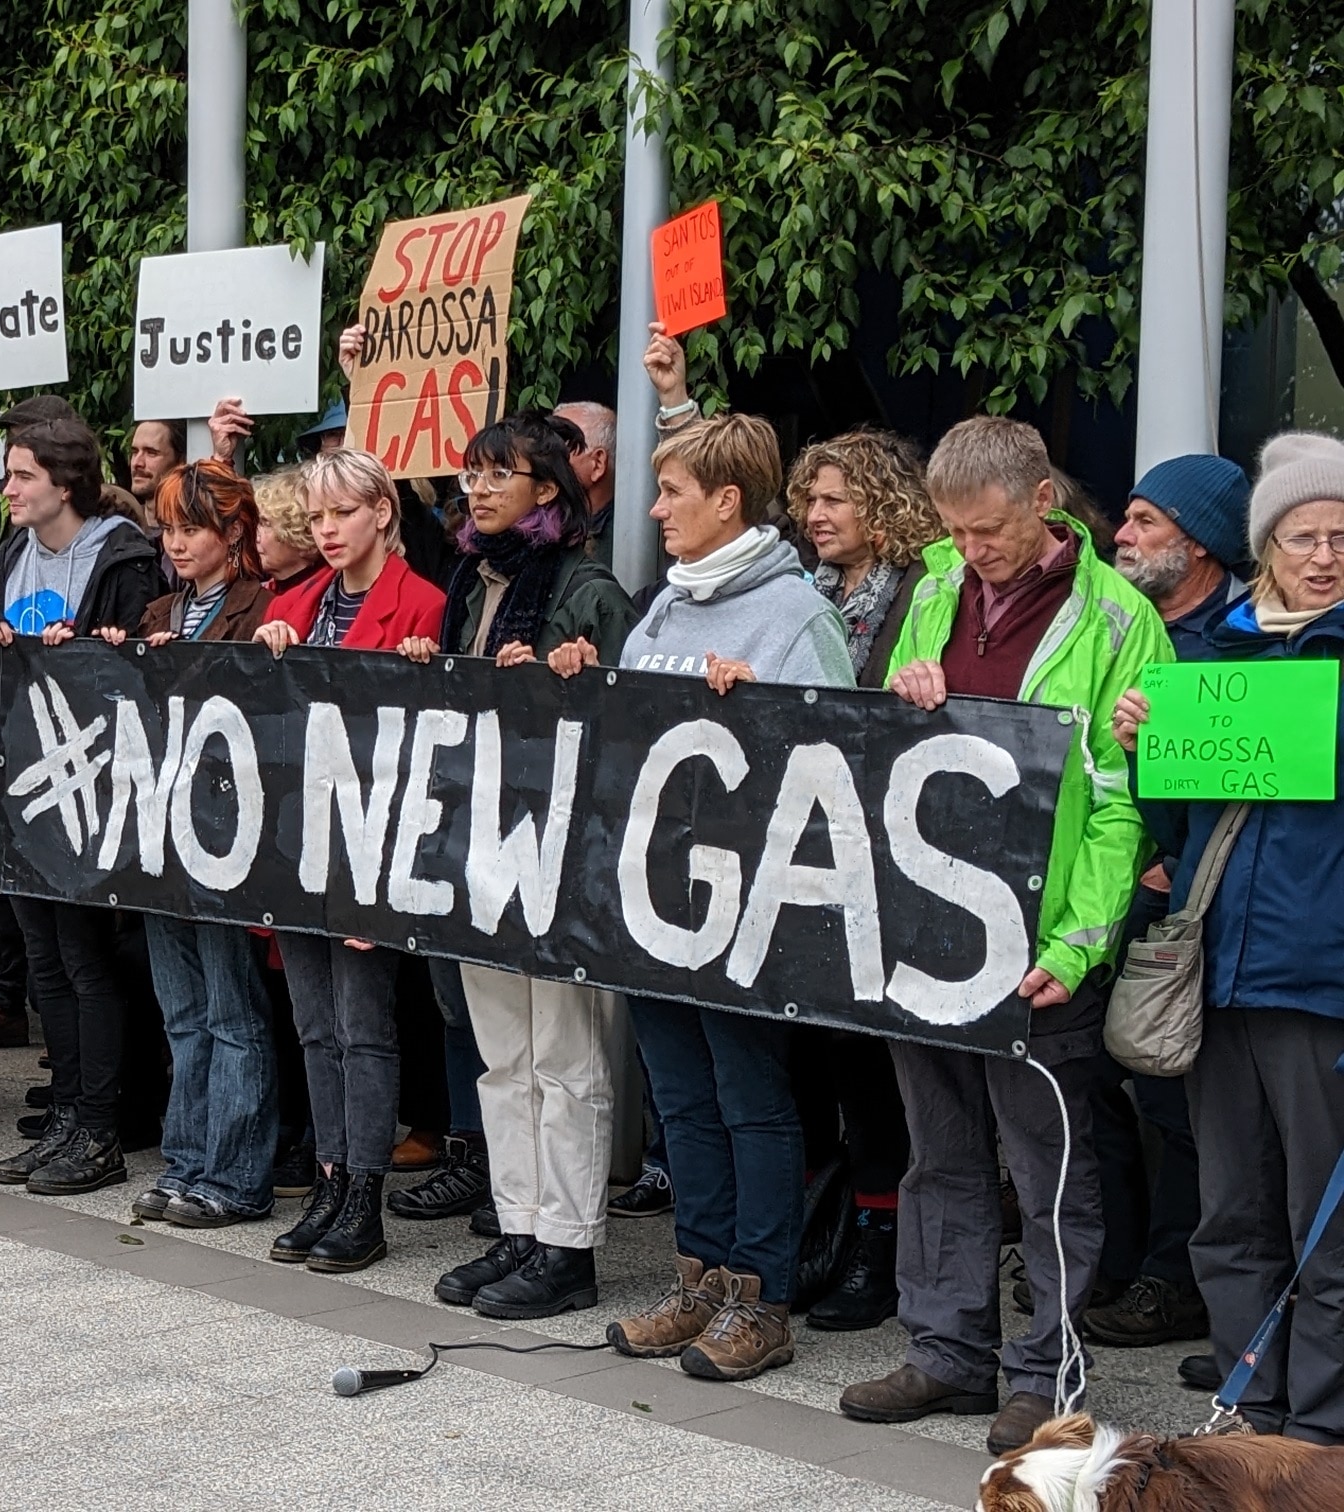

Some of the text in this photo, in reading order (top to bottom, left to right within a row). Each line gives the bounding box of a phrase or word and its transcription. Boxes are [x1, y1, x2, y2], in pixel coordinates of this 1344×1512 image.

[663, 209, 717, 257] SANTOS
[377, 211, 506, 303] STOP
[140, 317, 303, 369] Justice
[360, 285, 497, 368] BAROSSA
[1147, 667, 1162, 675] WE
[1198, 672, 1248, 703] NO
[1209, 715, 1233, 728] TO
[1146, 734, 1275, 763] BAROSSA
[1164, 769, 1280, 798] DIRTY GAS
[6, 674, 1029, 1026] #NO NEW GAS
